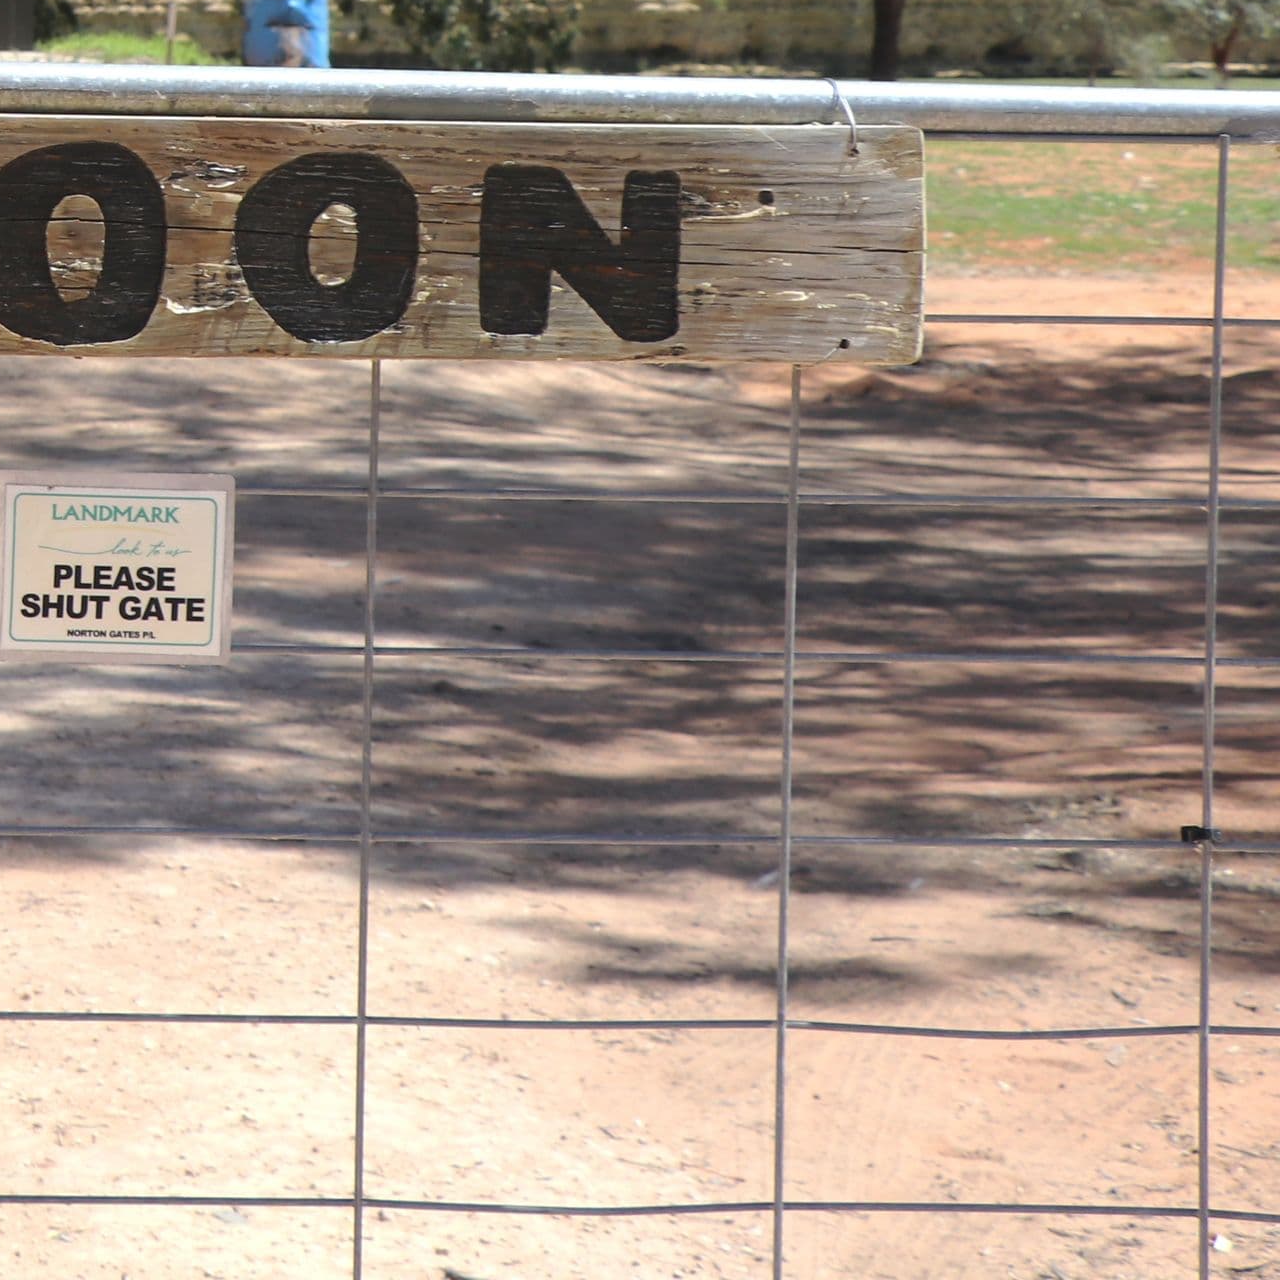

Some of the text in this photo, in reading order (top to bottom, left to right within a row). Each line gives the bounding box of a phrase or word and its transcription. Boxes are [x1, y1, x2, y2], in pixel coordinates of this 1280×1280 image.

[51, 503, 181, 524] LANDMARK
[111, 537, 143, 556] look
[146, 540, 165, 558] to
[53, 564, 176, 592] PLEASE
[20, 593, 206, 622] SHUT GATE
[66, 629, 107, 638] NORTON
[108, 630, 141, 639] GATES
